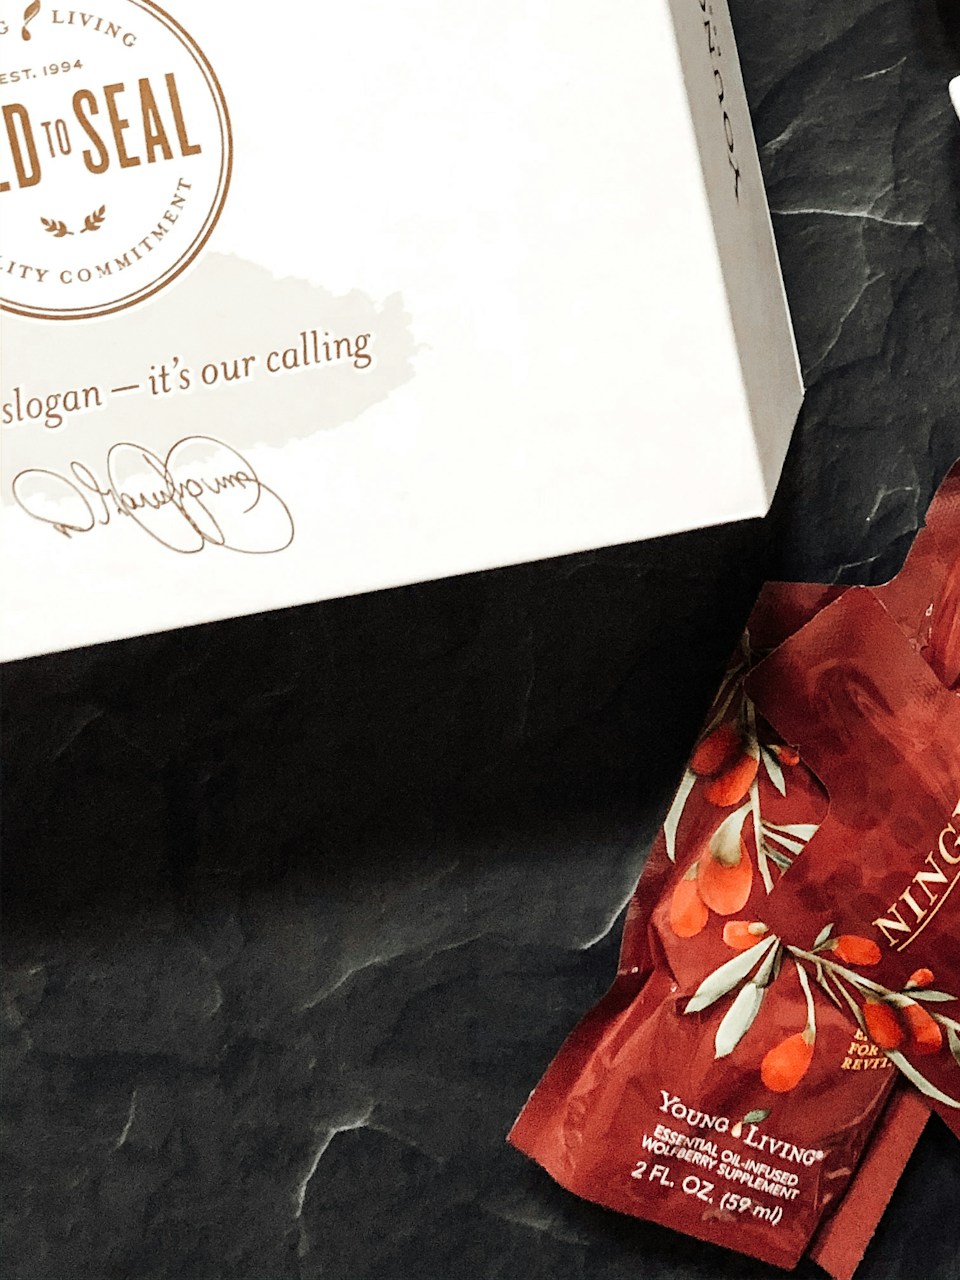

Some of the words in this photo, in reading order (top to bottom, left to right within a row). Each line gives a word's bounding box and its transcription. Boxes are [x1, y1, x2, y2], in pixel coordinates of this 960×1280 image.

[52, 9, 137, 48] LIVING
[0, 68, 37, 84] EST.
[43, 59, 83, 77] 1994
[41, 118, 72, 158] TO
[72, 72, 202, 175] SEAL
[60, 177, 192, 285] COMMITMENT
[2, 382, 103, 428] slogan
[201, 354, 256, 386] our
[266, 329, 373, 376] calling
[659, 1090, 730, 1133] YOUNG
[642, 1135, 717, 1170] WOLFBERRY
[717, 1164, 800, 1200] SUPPLEMENT
[654, 1124, 717, 1158] ESSENTIAL
[721, 1150, 799, 1187] OIL-INFUSED
[631, 1161, 647, 1179] 2
[650, 1164, 675, 1188] FL.
[682, 1175, 713, 1204] OZ.
[720, 1191, 751, 1212] (59
[752, 1203, 783, 1227] ml)
